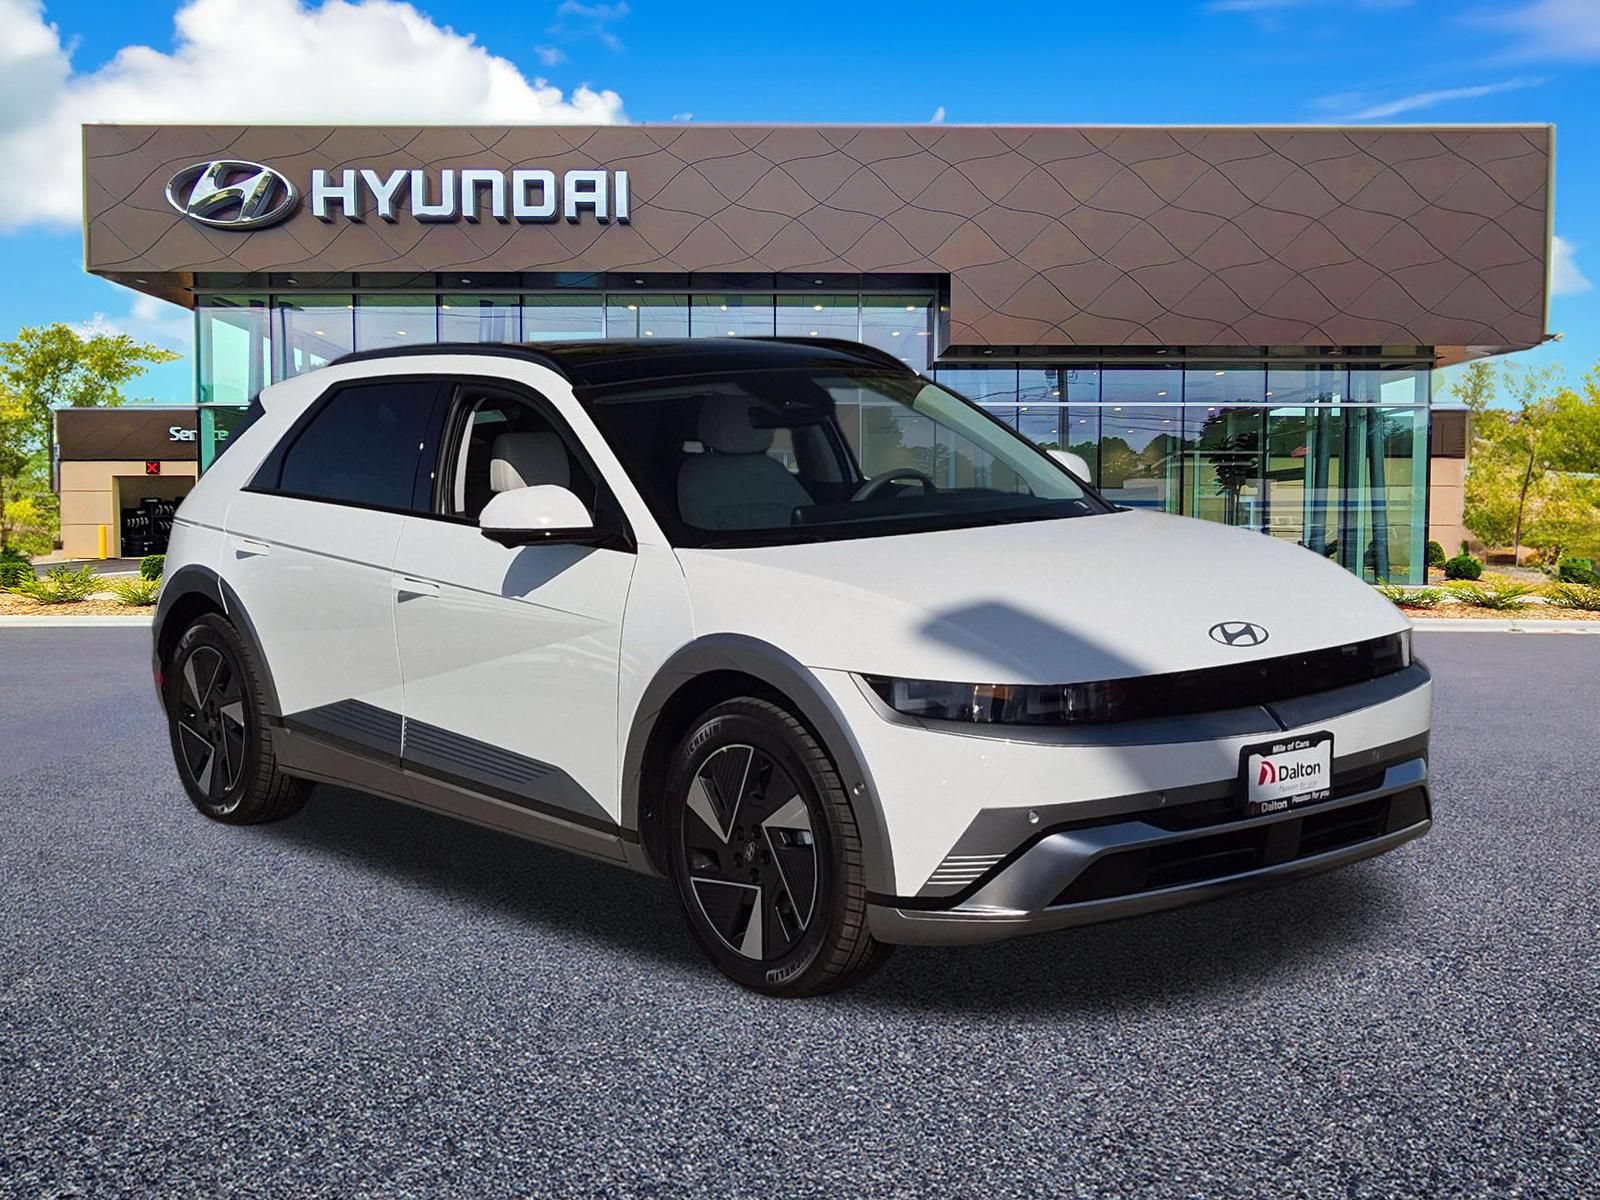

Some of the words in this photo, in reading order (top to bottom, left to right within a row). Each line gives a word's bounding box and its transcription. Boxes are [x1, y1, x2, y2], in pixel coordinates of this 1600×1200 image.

[312, 168, 630, 222] HYUNDAI
[1272, 744, 1286, 753] Mile
[1287, 742, 1295, 750] of
[1295, 740, 1310, 749] Cars
[1279, 762, 1321, 782] Dalton
[1319, 789, 1330, 799] you
[1261, 800, 1288, 813] Dalton
